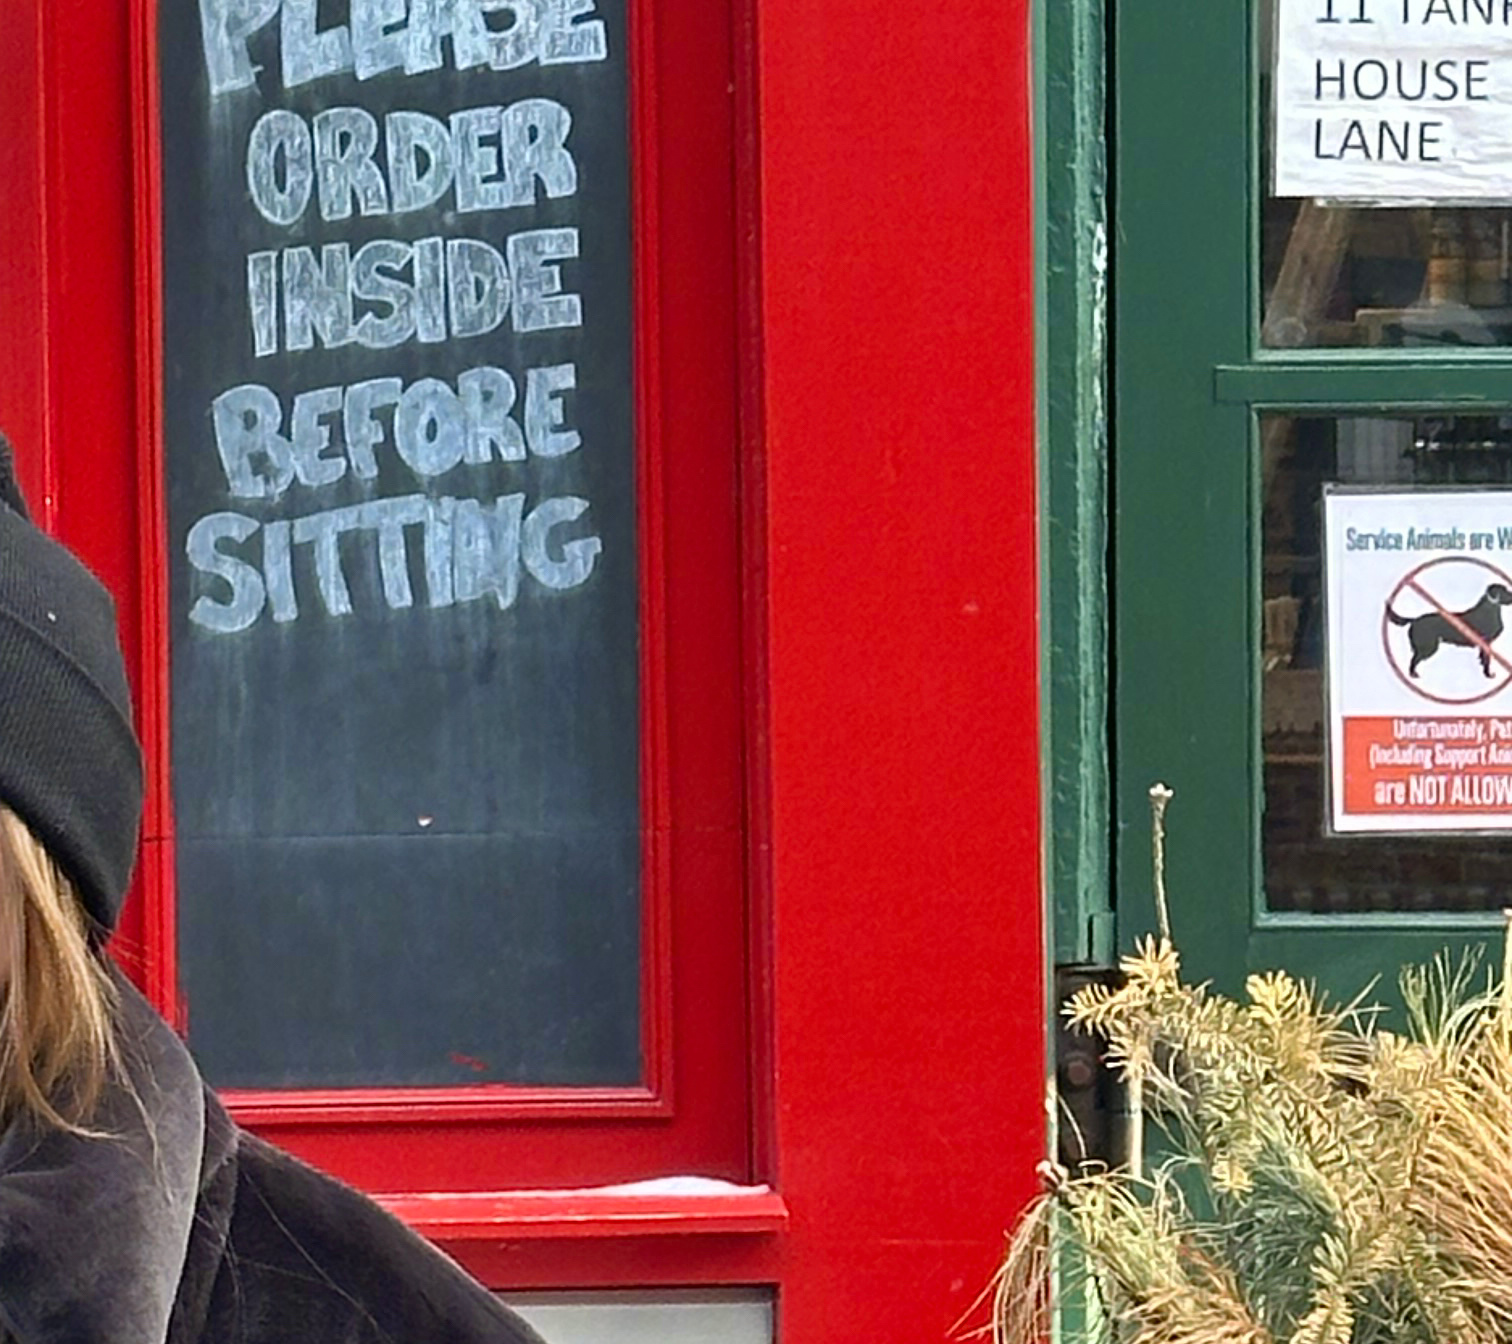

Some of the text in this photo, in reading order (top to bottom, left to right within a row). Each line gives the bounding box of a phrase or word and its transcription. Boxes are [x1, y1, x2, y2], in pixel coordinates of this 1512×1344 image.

[1315, 59, 1489, 101] HOUSE
[246, 98, 579, 225] ORDER
[1314, 118, 1443, 162] LANE
[246, 227, 582, 357] INSIDE
[212, 363, 582, 501] BEFORE
[1346, 527, 1402, 550] Service
[1407, 527, 1465, 550] Animals
[1470, 533, 1494, 550] are
[186, 493, 603, 632] SITTING
[1434, 743, 1486, 769] Support
[1374, 781, 1406, 805] are
[1409, 775, 1448, 805] NOT
